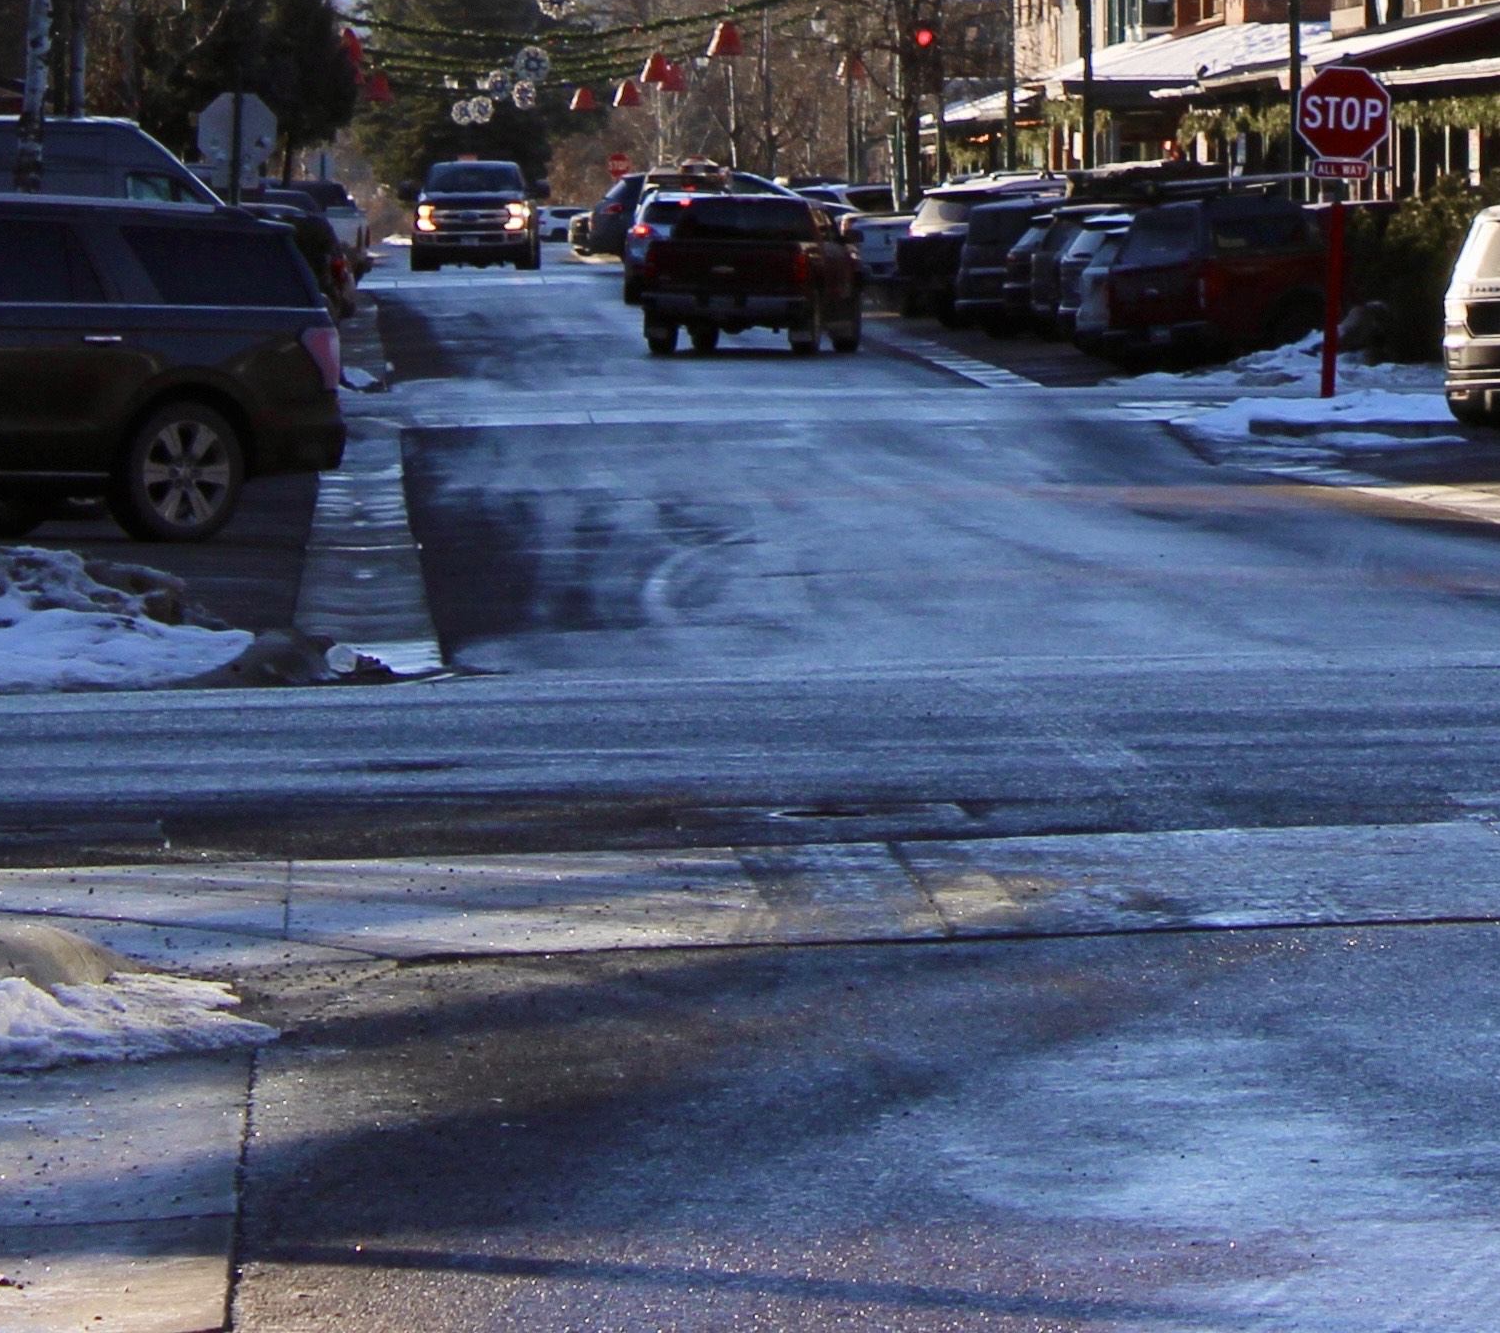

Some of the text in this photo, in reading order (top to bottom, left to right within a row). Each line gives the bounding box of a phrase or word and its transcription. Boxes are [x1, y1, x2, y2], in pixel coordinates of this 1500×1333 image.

[1303, 95, 1383, 131] STOP
[1317, 164, 1364, 175] ALL WAY
